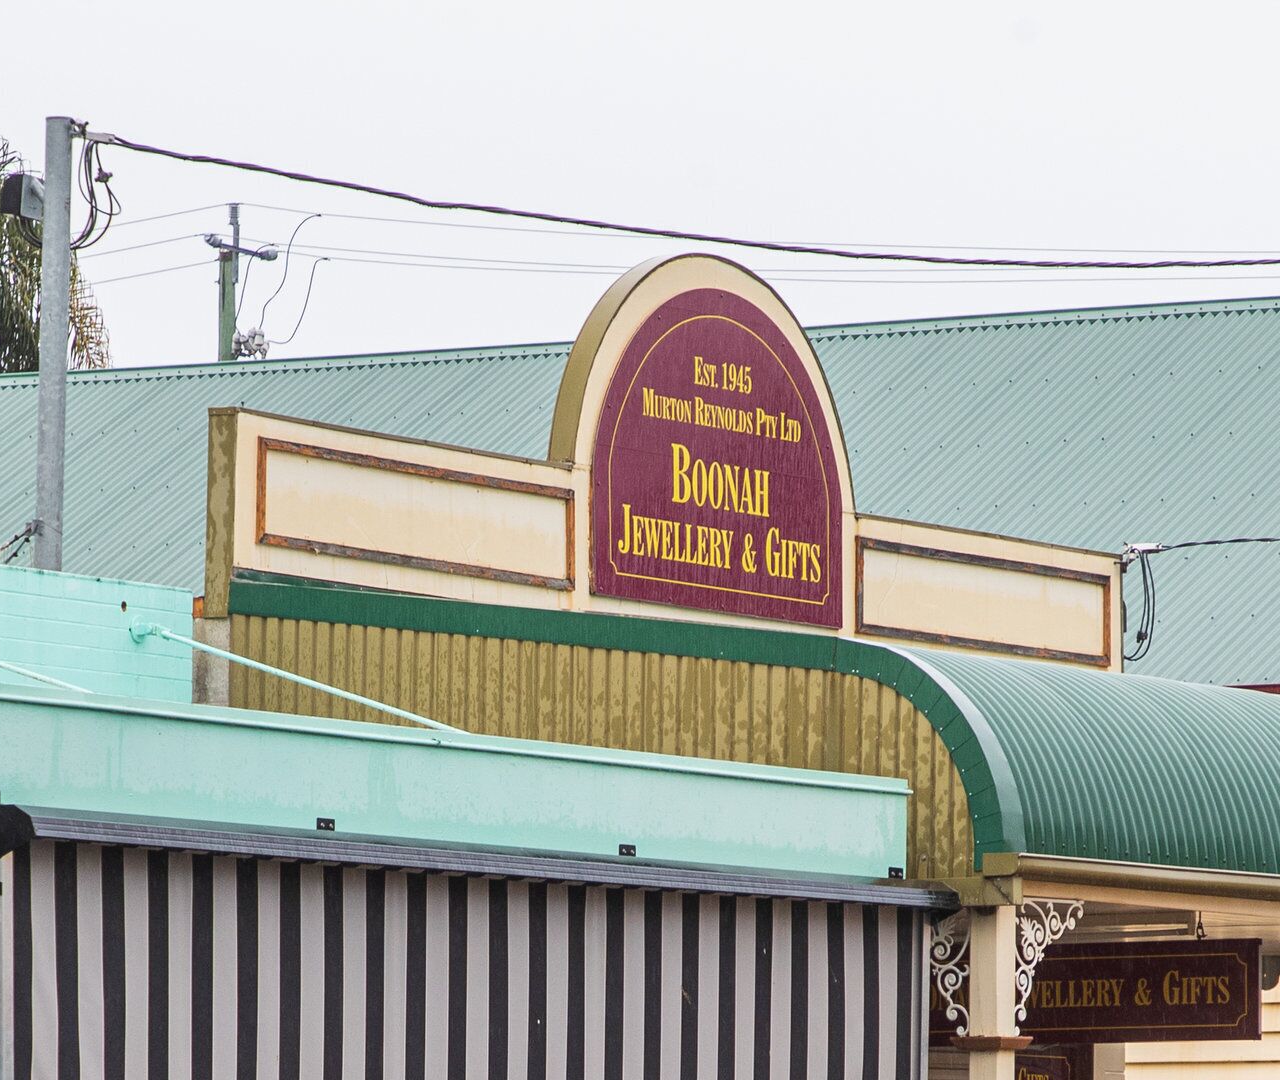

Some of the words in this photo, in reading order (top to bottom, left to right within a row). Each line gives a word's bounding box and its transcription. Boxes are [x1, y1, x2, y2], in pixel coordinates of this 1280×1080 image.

[722, 362, 752, 394] 1945
[643, 387, 692, 425] MURTON
[695, 396, 753, 435] REYNOLDS
[756, 408, 778, 438] PTY
[780, 412, 801, 443] LTD
[671, 442, 770, 518] BOONAH
[618, 503, 734, 569] JEWELLERY
[741, 533, 757, 574] &
[766, 527, 821, 584] GIFTS
[1134, 978, 1152, 1006] &
[1163, 970, 1231, 1006] GIFTS
